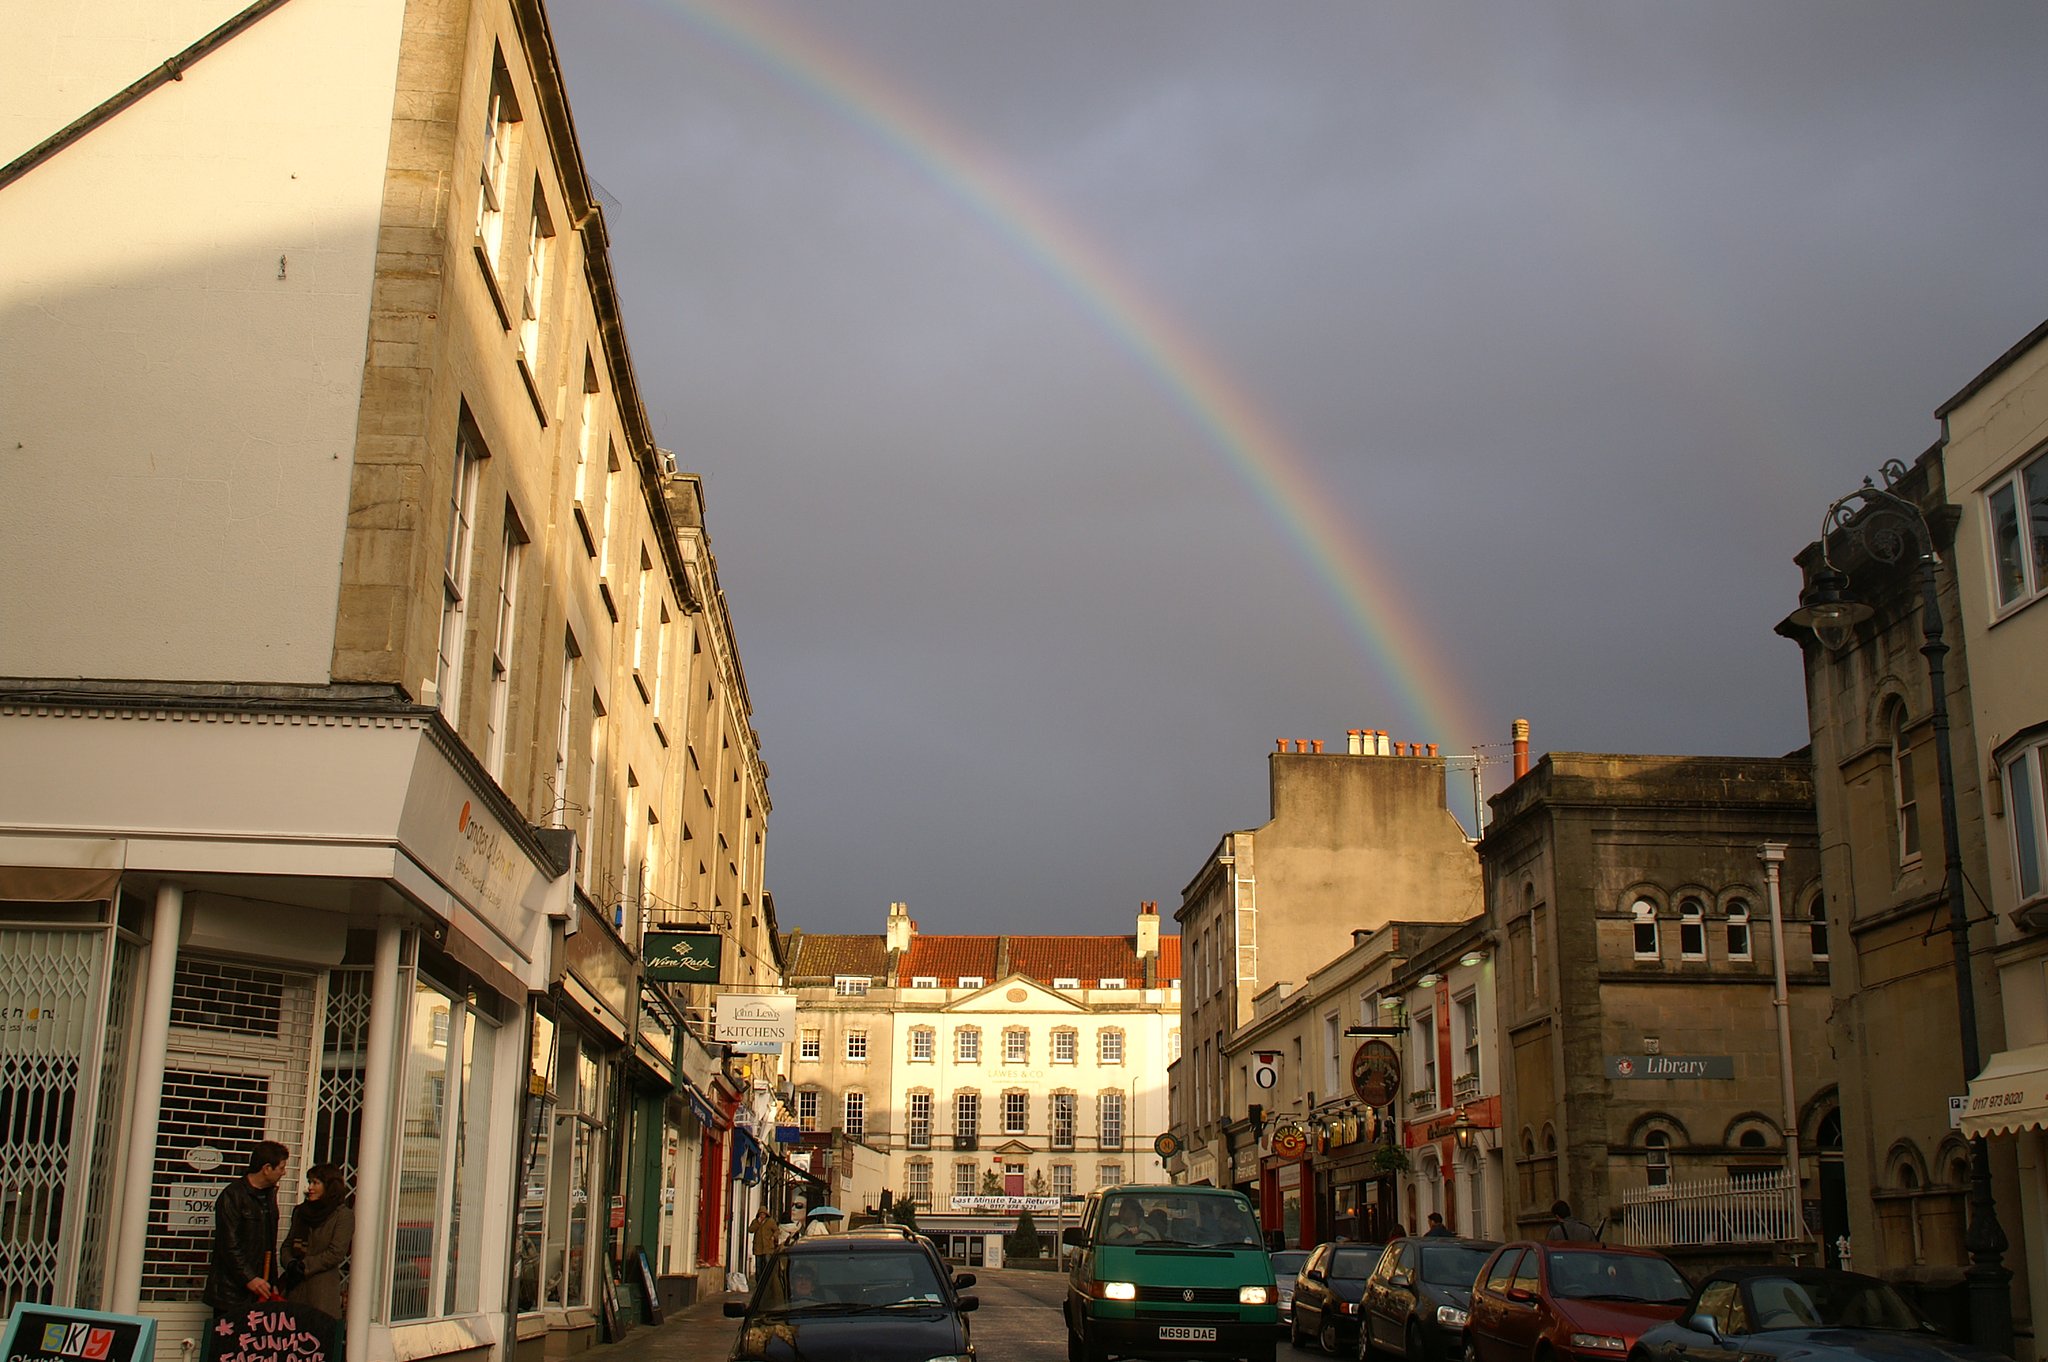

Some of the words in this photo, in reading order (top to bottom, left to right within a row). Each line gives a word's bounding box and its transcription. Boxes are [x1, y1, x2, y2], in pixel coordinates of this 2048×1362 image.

[647, 956, 680, 968] Wine
[679, 956, 716, 971] Rack
[726, 1026, 785, 1038] KITCHENS
[1647, 1058, 1708, 1077] Library
[1972, 1097, 1989, 1111] 0117
[1989, 1094, 2004, 1108] 973
[2003, 1091, 2024, 1106] 8020
[184, 1200, 213, 1212] 50%
[247, 1310, 296, 1333] FUN
[1160, 1328, 1190, 1338] M698
[1193, 1329, 1215, 1339] DAE
[239, 1332, 321, 1355] FUNKY
